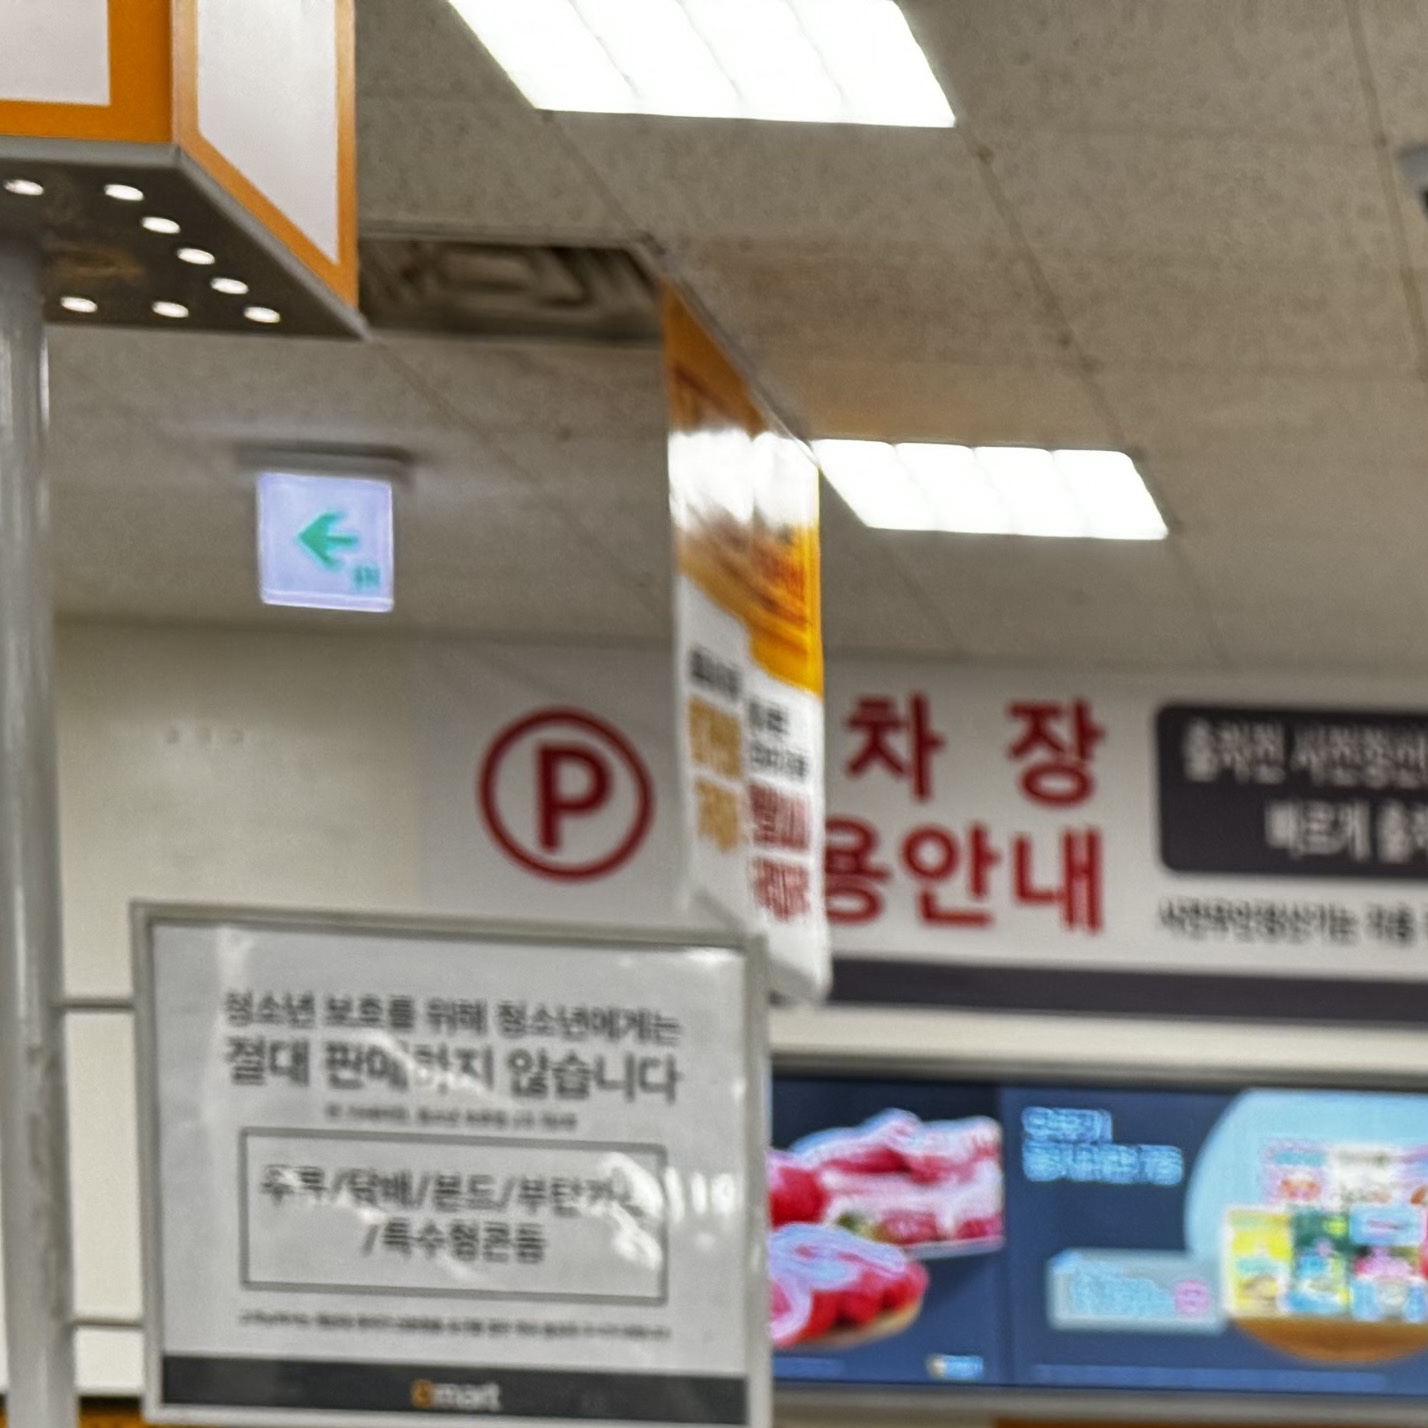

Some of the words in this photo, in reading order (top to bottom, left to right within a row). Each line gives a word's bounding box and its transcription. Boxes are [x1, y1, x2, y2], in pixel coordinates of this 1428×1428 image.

[844, 691, 946, 802] 차
[1008, 695, 1104, 807] 장
[824, 815, 1103, 933] 용안내
[228, 1036, 310, 1088] 절대
[506, 1047, 683, 1103] 않습니다
